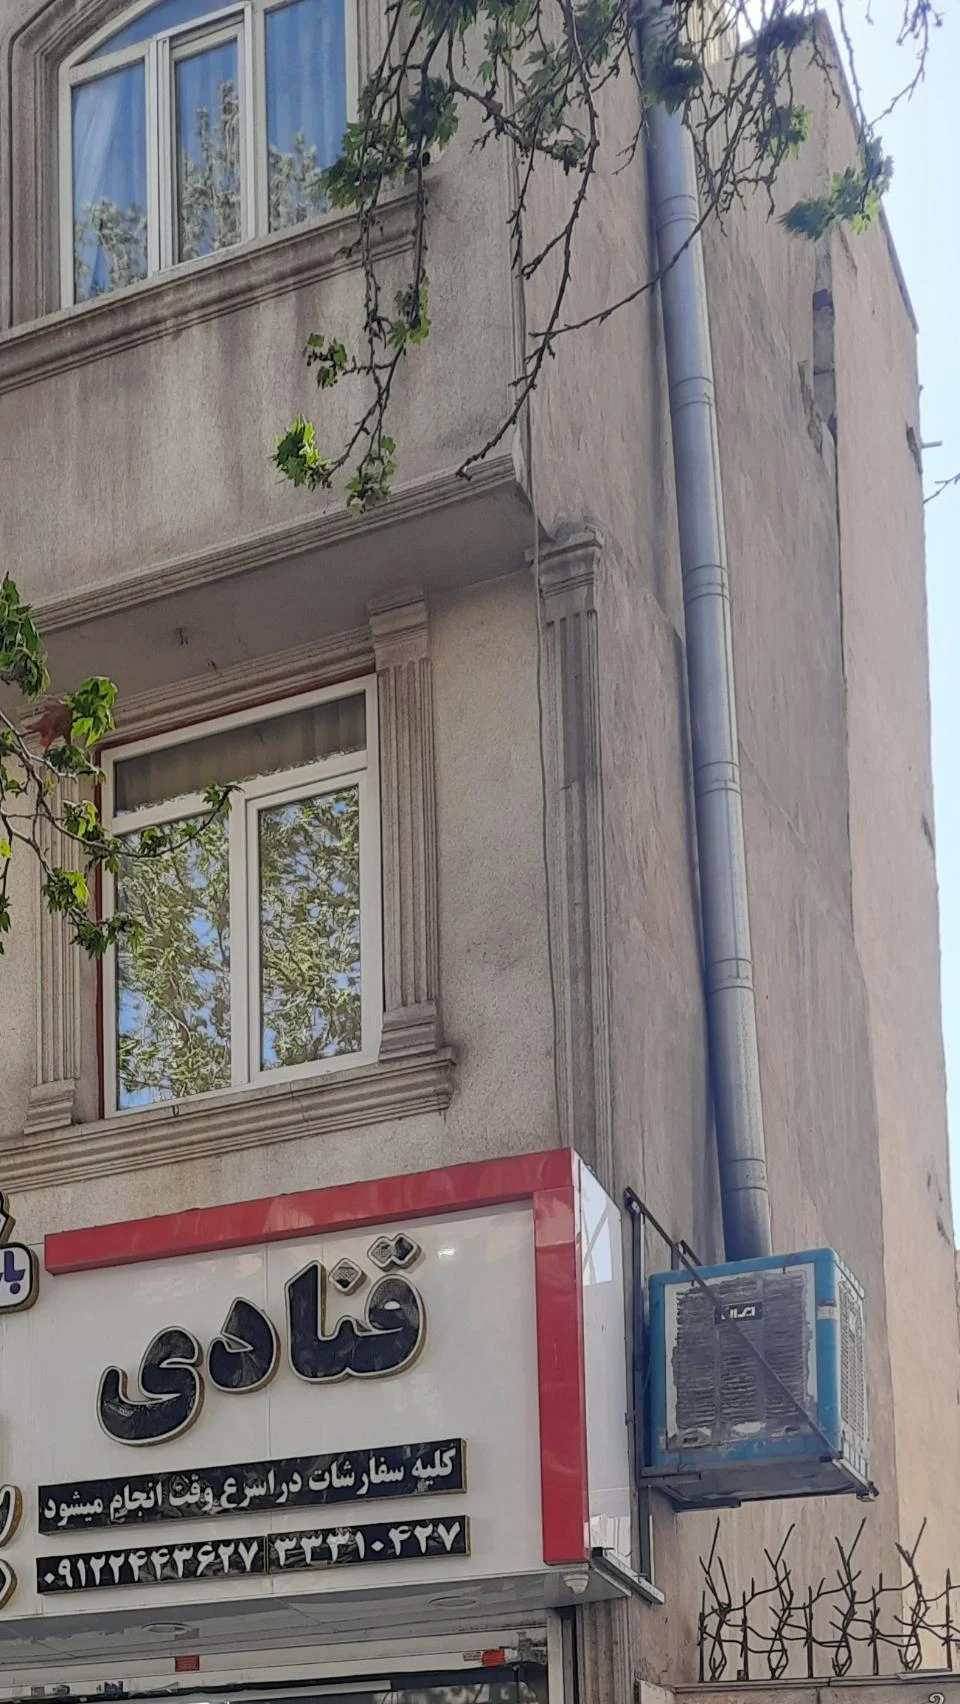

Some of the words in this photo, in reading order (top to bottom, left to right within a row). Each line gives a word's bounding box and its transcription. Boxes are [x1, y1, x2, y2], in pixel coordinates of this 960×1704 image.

[97, 1233, 426, 1446] قنادی
[308, 1456, 405, 1495] سفارشات
[411, 1445, 456, 1485] کلیه
[43, 1490, 104, 1526] میشود
[109, 1480, 162, 1521] انجام
[169, 1474, 213, 1512] وقت
[43, 1540, 259, 1588] ۰۹۱۲۲۴۴۳۶۲۷
[274, 1521, 460, 1567] ۳۳۳۱۰۴۲۷
